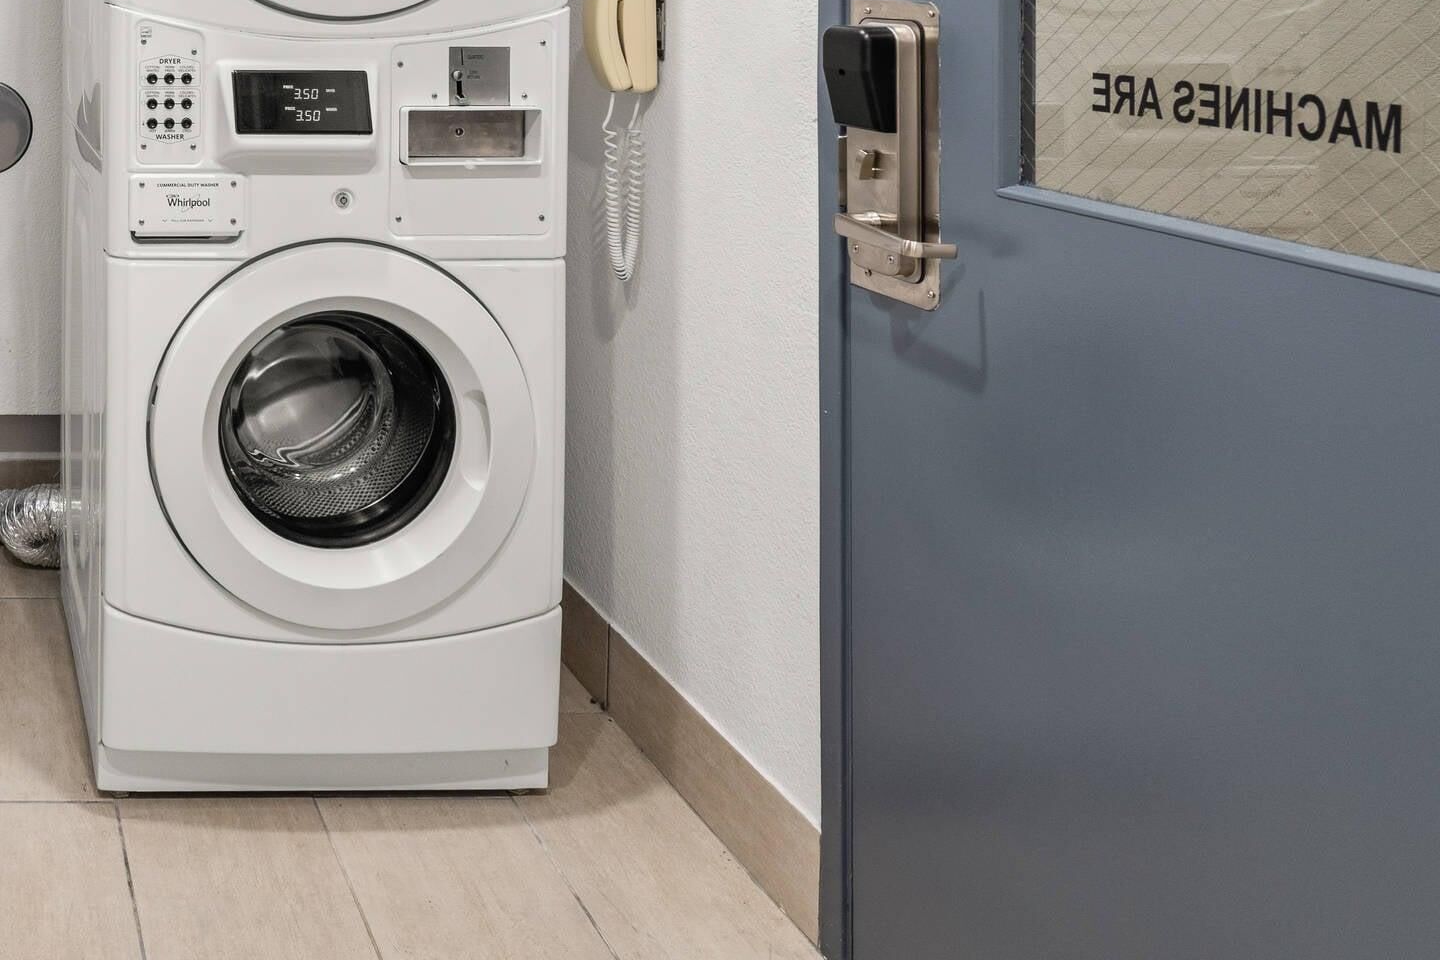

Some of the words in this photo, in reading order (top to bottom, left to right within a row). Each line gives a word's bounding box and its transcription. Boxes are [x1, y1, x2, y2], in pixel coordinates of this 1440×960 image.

[294, 88, 319, 100] 3.50
[296, 110, 321, 122] 3.50
[167, 198, 210, 208] Whirlpool
